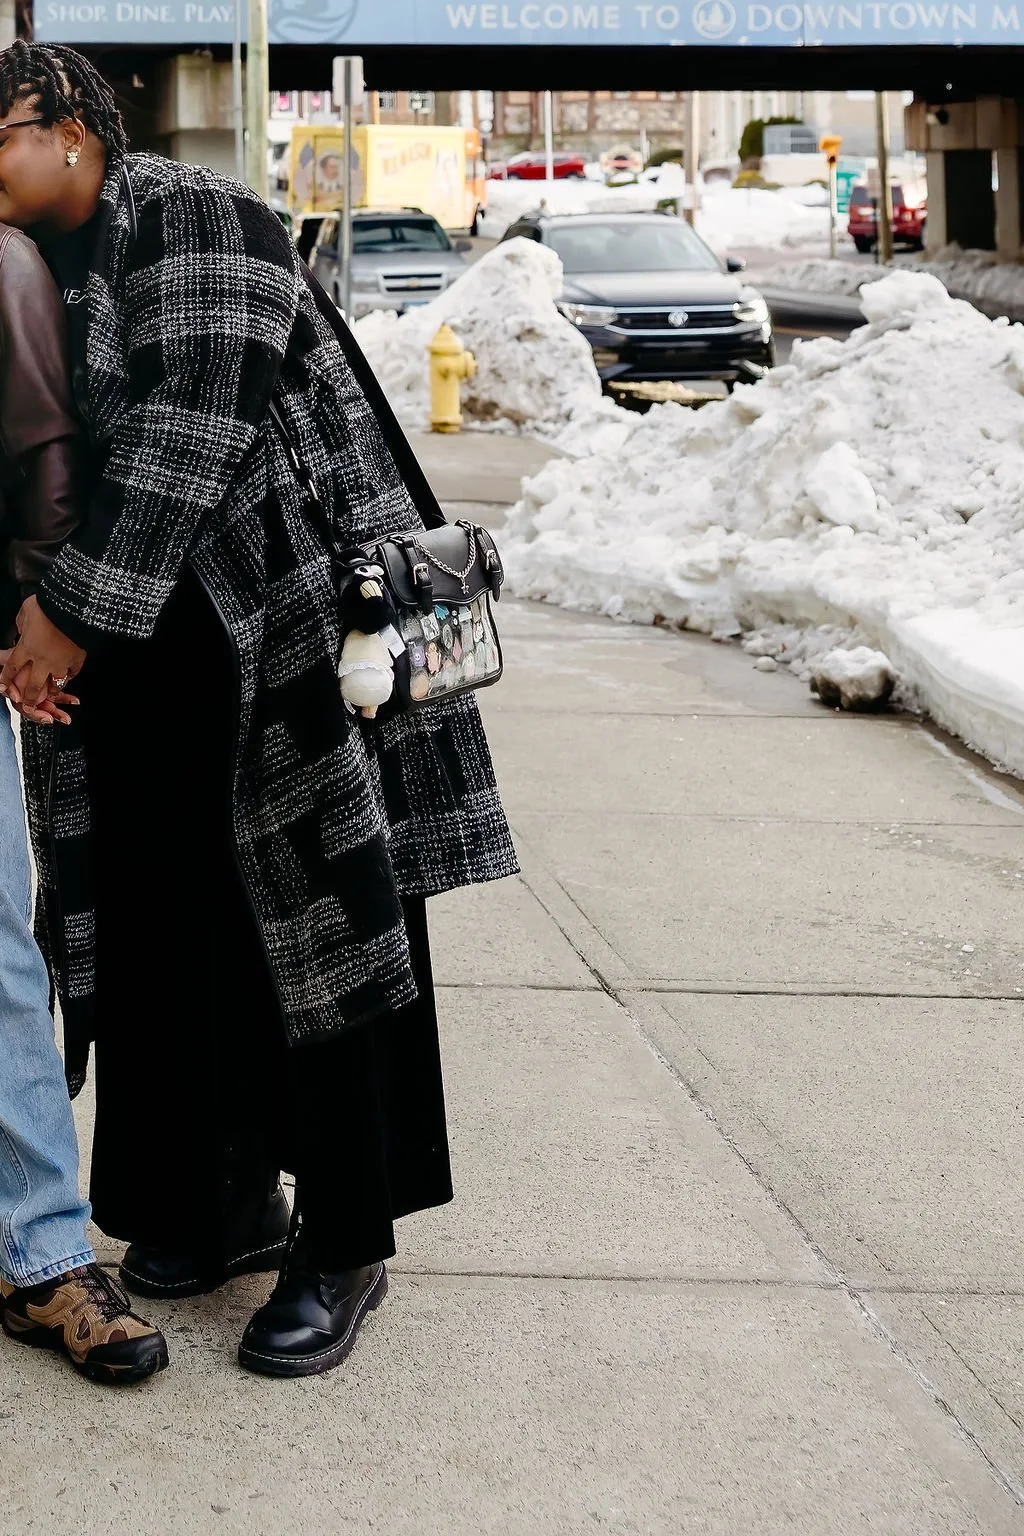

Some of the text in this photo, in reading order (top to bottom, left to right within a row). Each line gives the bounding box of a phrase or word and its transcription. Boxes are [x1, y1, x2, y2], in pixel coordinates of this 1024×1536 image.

[446, 4, 620, 30] WELCOME
[634, 5, 680, 29] TO
[747, 2, 976, 32] DOWNTOWN
